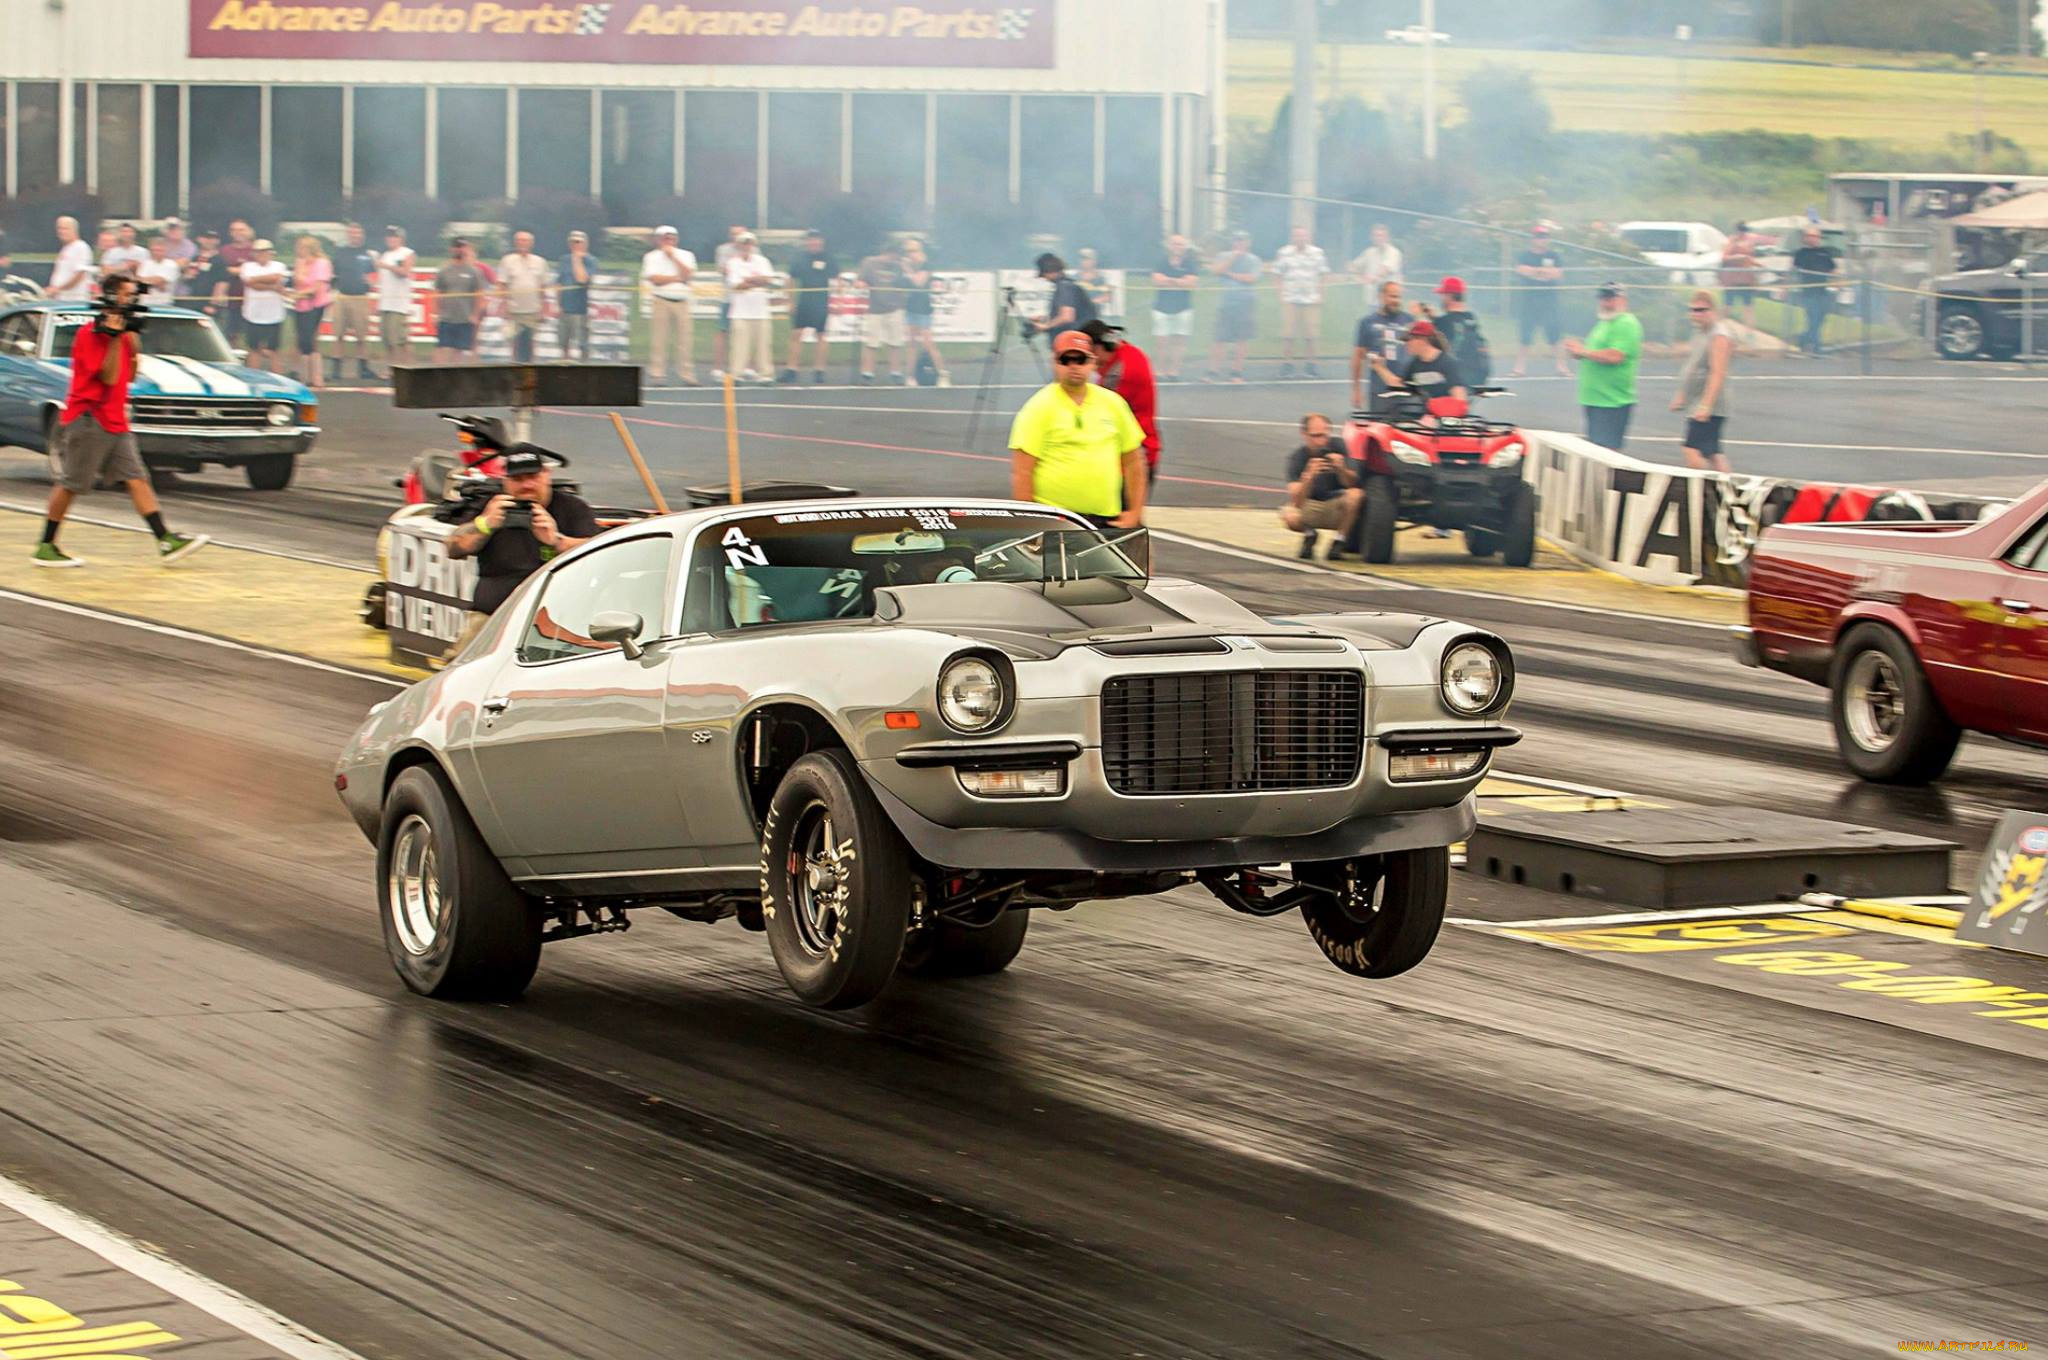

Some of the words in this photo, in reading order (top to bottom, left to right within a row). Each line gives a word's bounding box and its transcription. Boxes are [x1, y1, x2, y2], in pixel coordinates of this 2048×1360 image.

[209, 0, 370, 31] Advance
[368, 3, 469, 33] Auto
[468, 2, 574, 34] Parts
[624, 3, 787, 36] Advance
[787, 5, 888, 37] Auto
[887, 6, 994, 39] Parts
[819, 510, 864, 521] DRAG
[863, 509, 909, 519] WEEK
[721, 526, 752, 547] 4
[724, 544, 770, 571] N
[691, 730, 713, 744] SS
